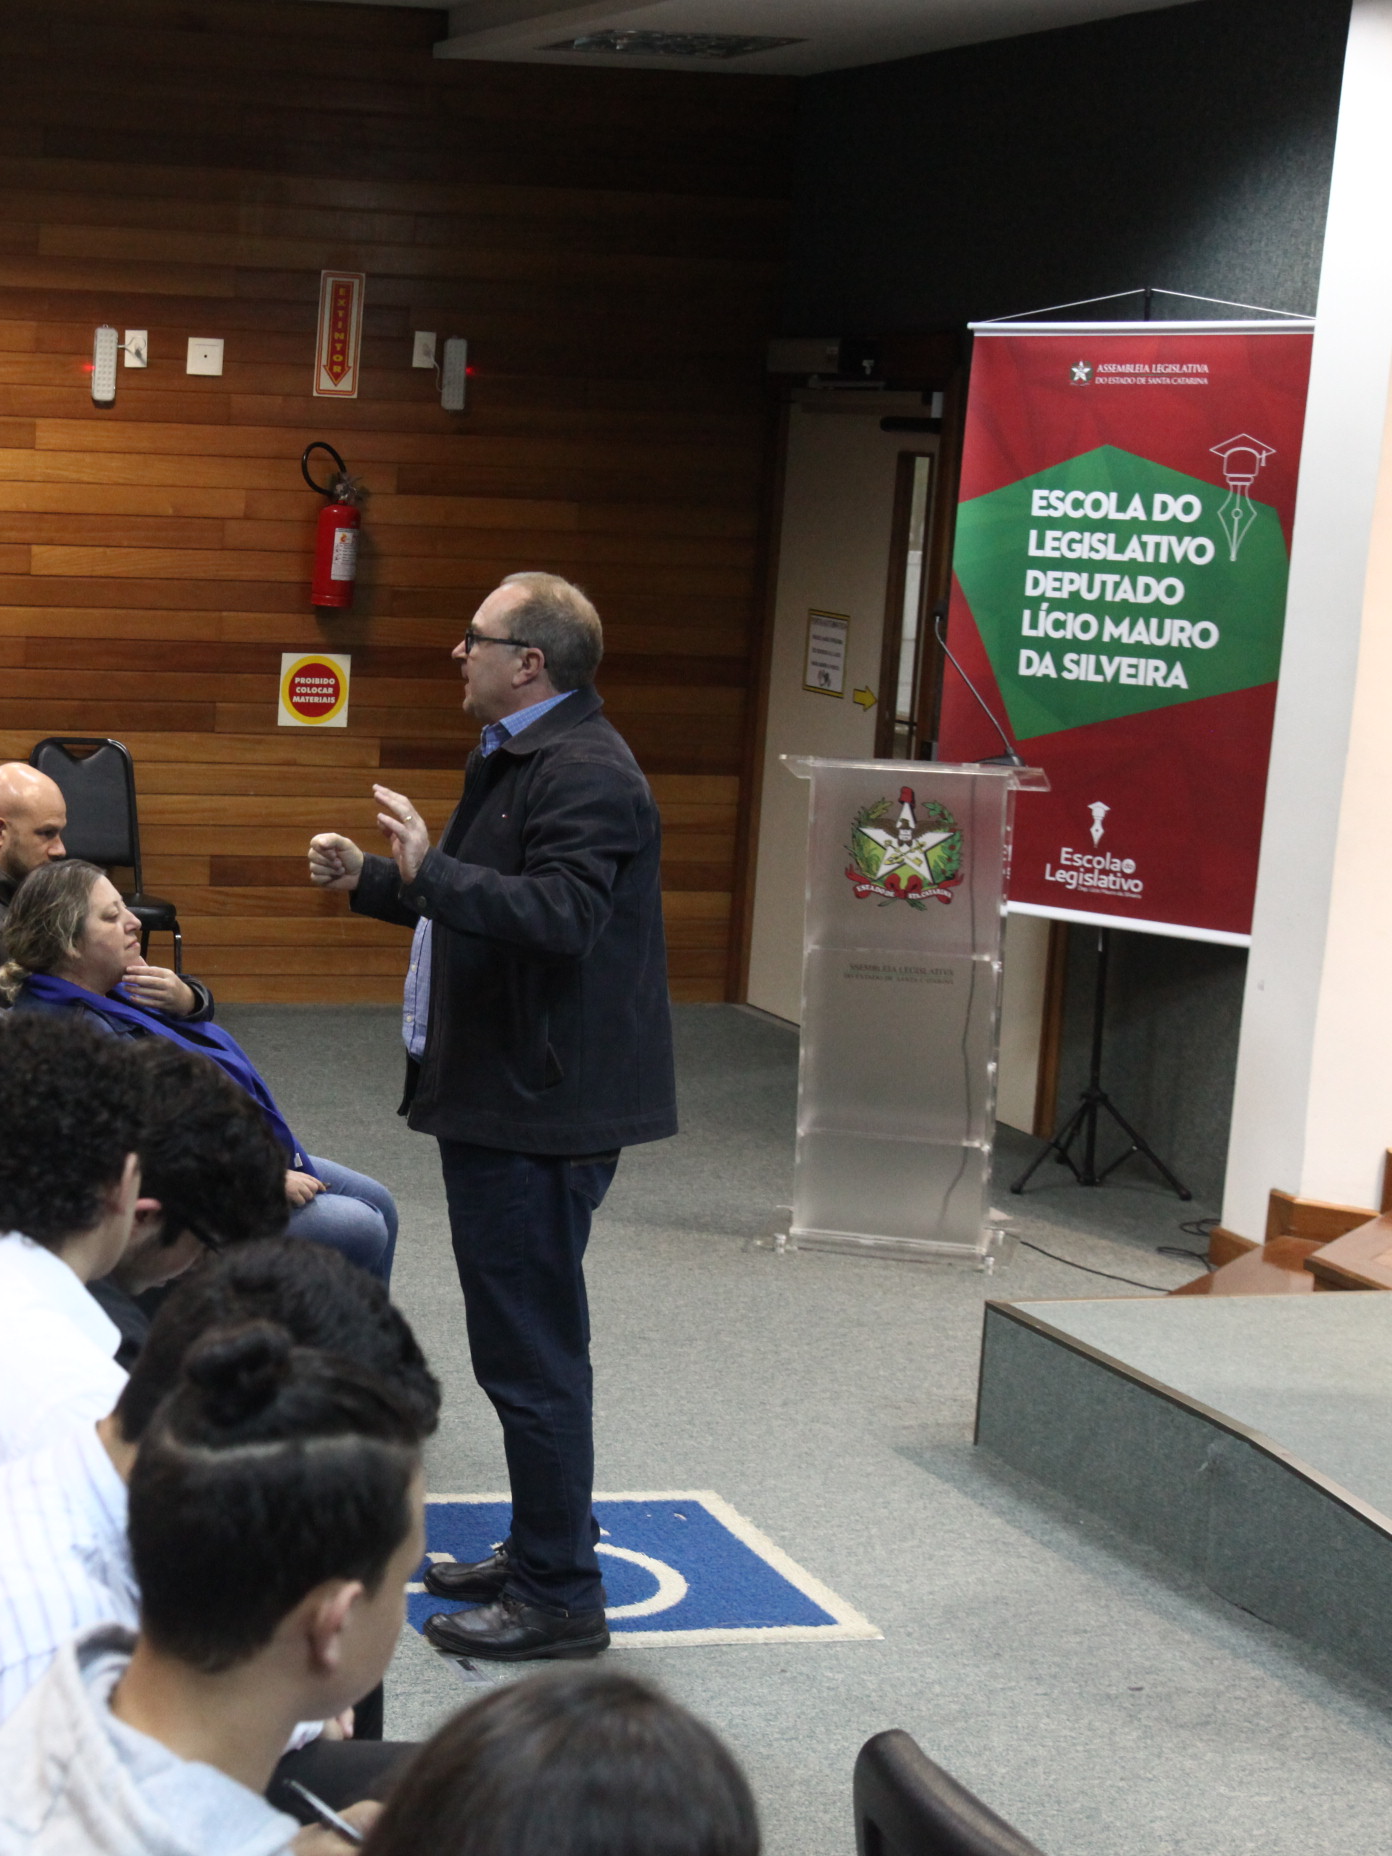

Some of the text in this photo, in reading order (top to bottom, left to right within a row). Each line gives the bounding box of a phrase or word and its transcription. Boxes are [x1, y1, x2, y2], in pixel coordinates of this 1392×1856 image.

[333, 287, 346, 373] EXTINTOR
[1097, 364, 1209, 374] ASSEMBLEIA LEGISLATIVA
[1108, 376, 1136, 384] ESTADO
[1147, 376, 1170, 385] SANTA
[1171, 376, 1208, 385] CATARINA
[1030, 488, 1203, 523] ESCOLA DO
[1027, 529, 1216, 566] LEGISLATIVO
[1024, 569, 1185, 606] DEPUTADO
[1021, 602, 1220, 650] LÍCIO MAURO
[294, 677, 336, 685] PROIBIDO
[1018, 648, 1189, 690] DA SILVEIRA
[292, 696, 336, 704] MATERIAIS
[295, 686, 333, 694] COLOCAR
[1060, 847, 1121, 872] Escola
[1044, 863, 1144, 893] Legislativo
